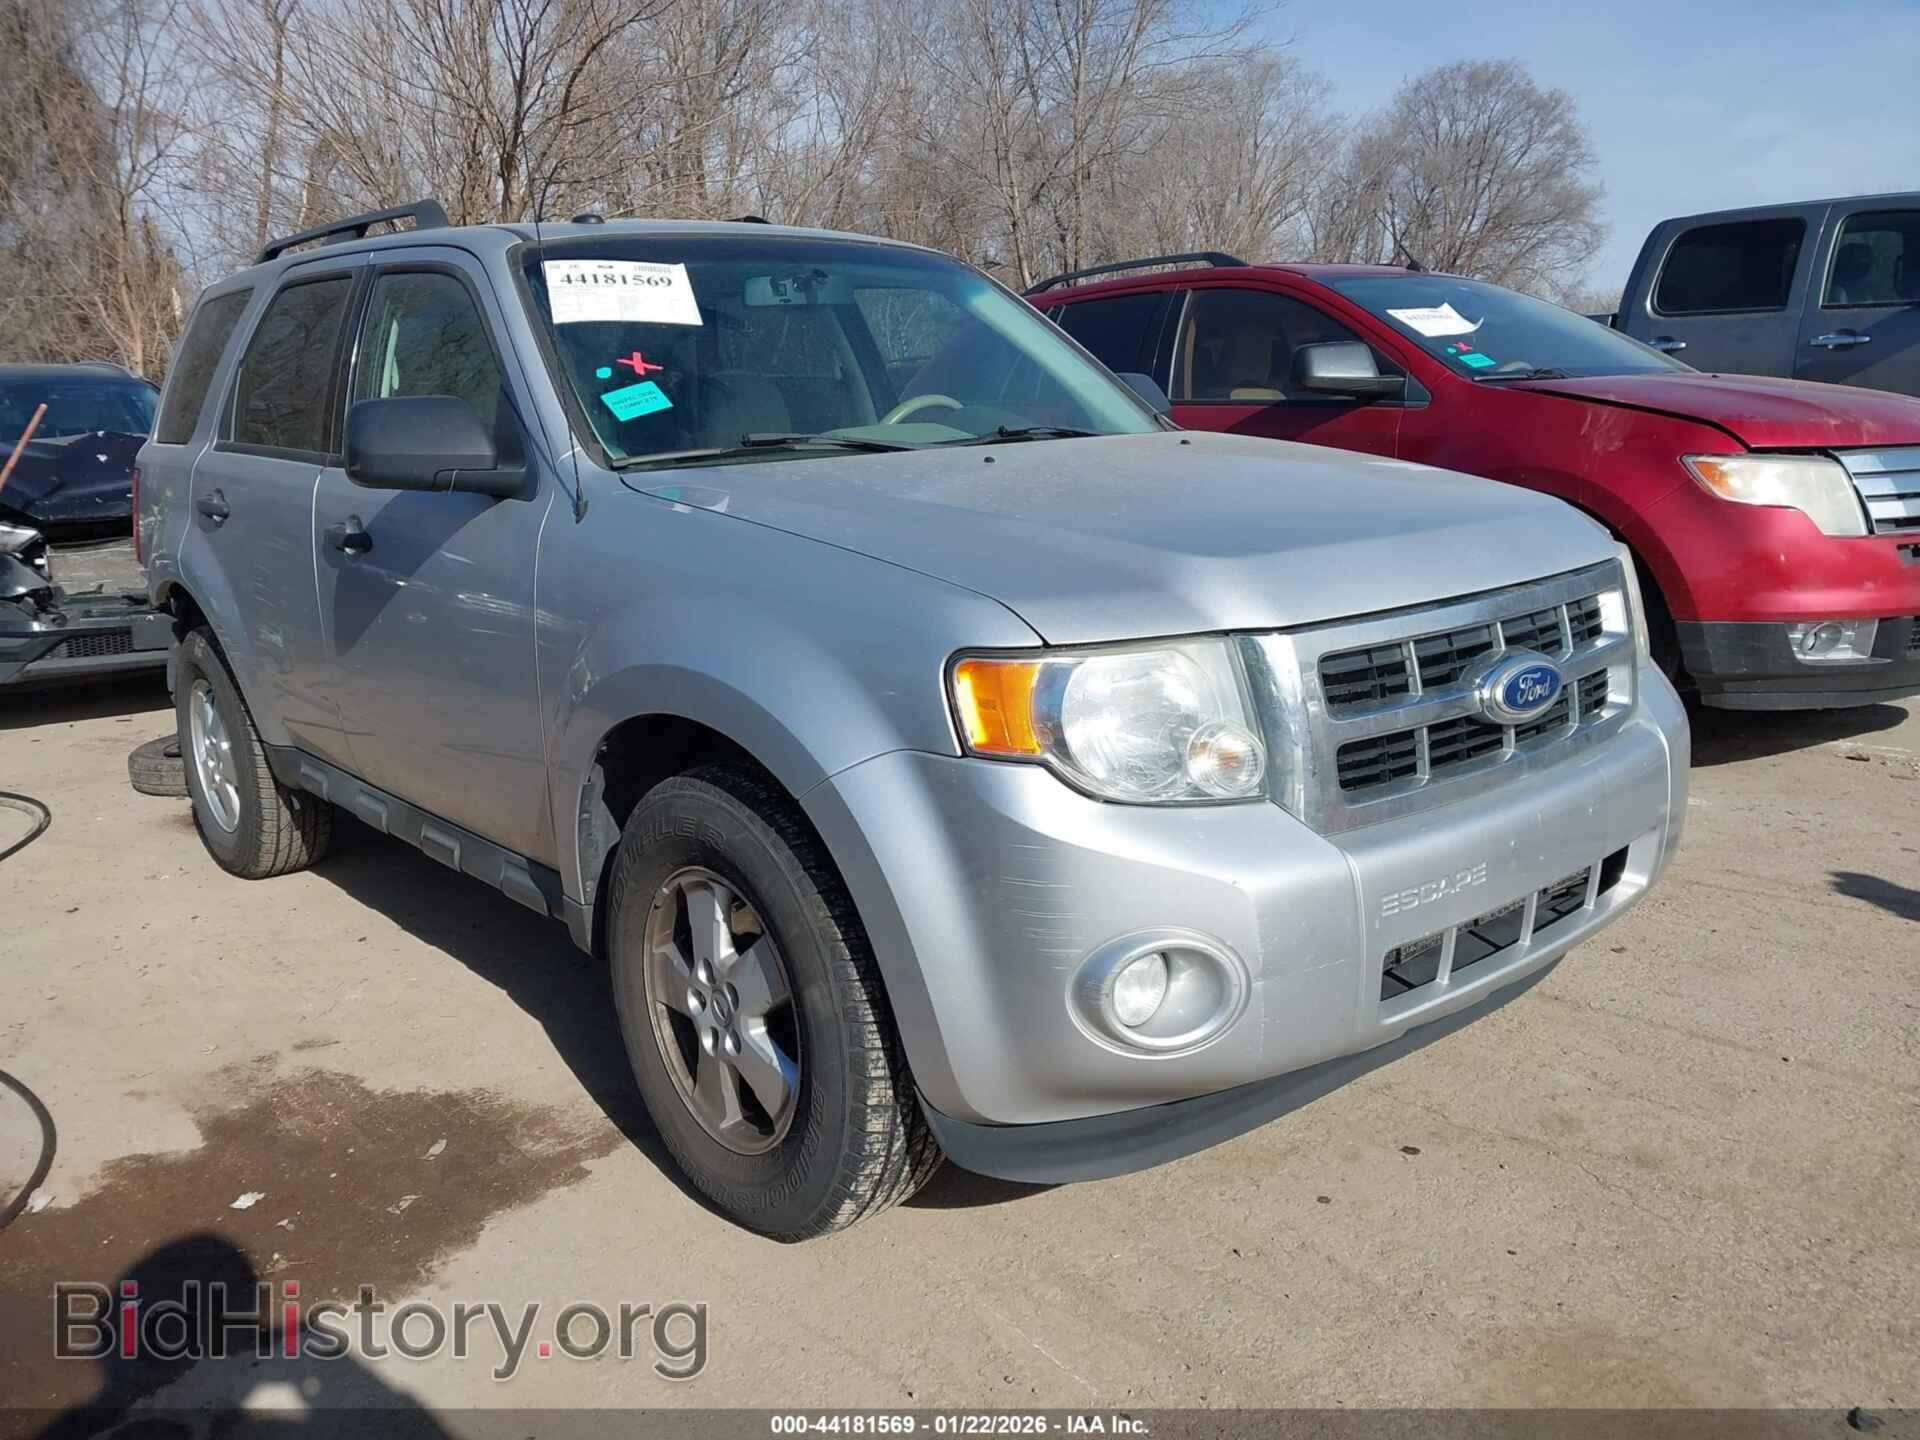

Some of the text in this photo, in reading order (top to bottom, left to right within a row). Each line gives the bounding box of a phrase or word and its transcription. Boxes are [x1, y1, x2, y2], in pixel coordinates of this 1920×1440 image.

[560, 273, 672, 287] 44181569
[1517, 671, 1551, 704] Ford
[1381, 861, 1488, 917] ESCAPE
